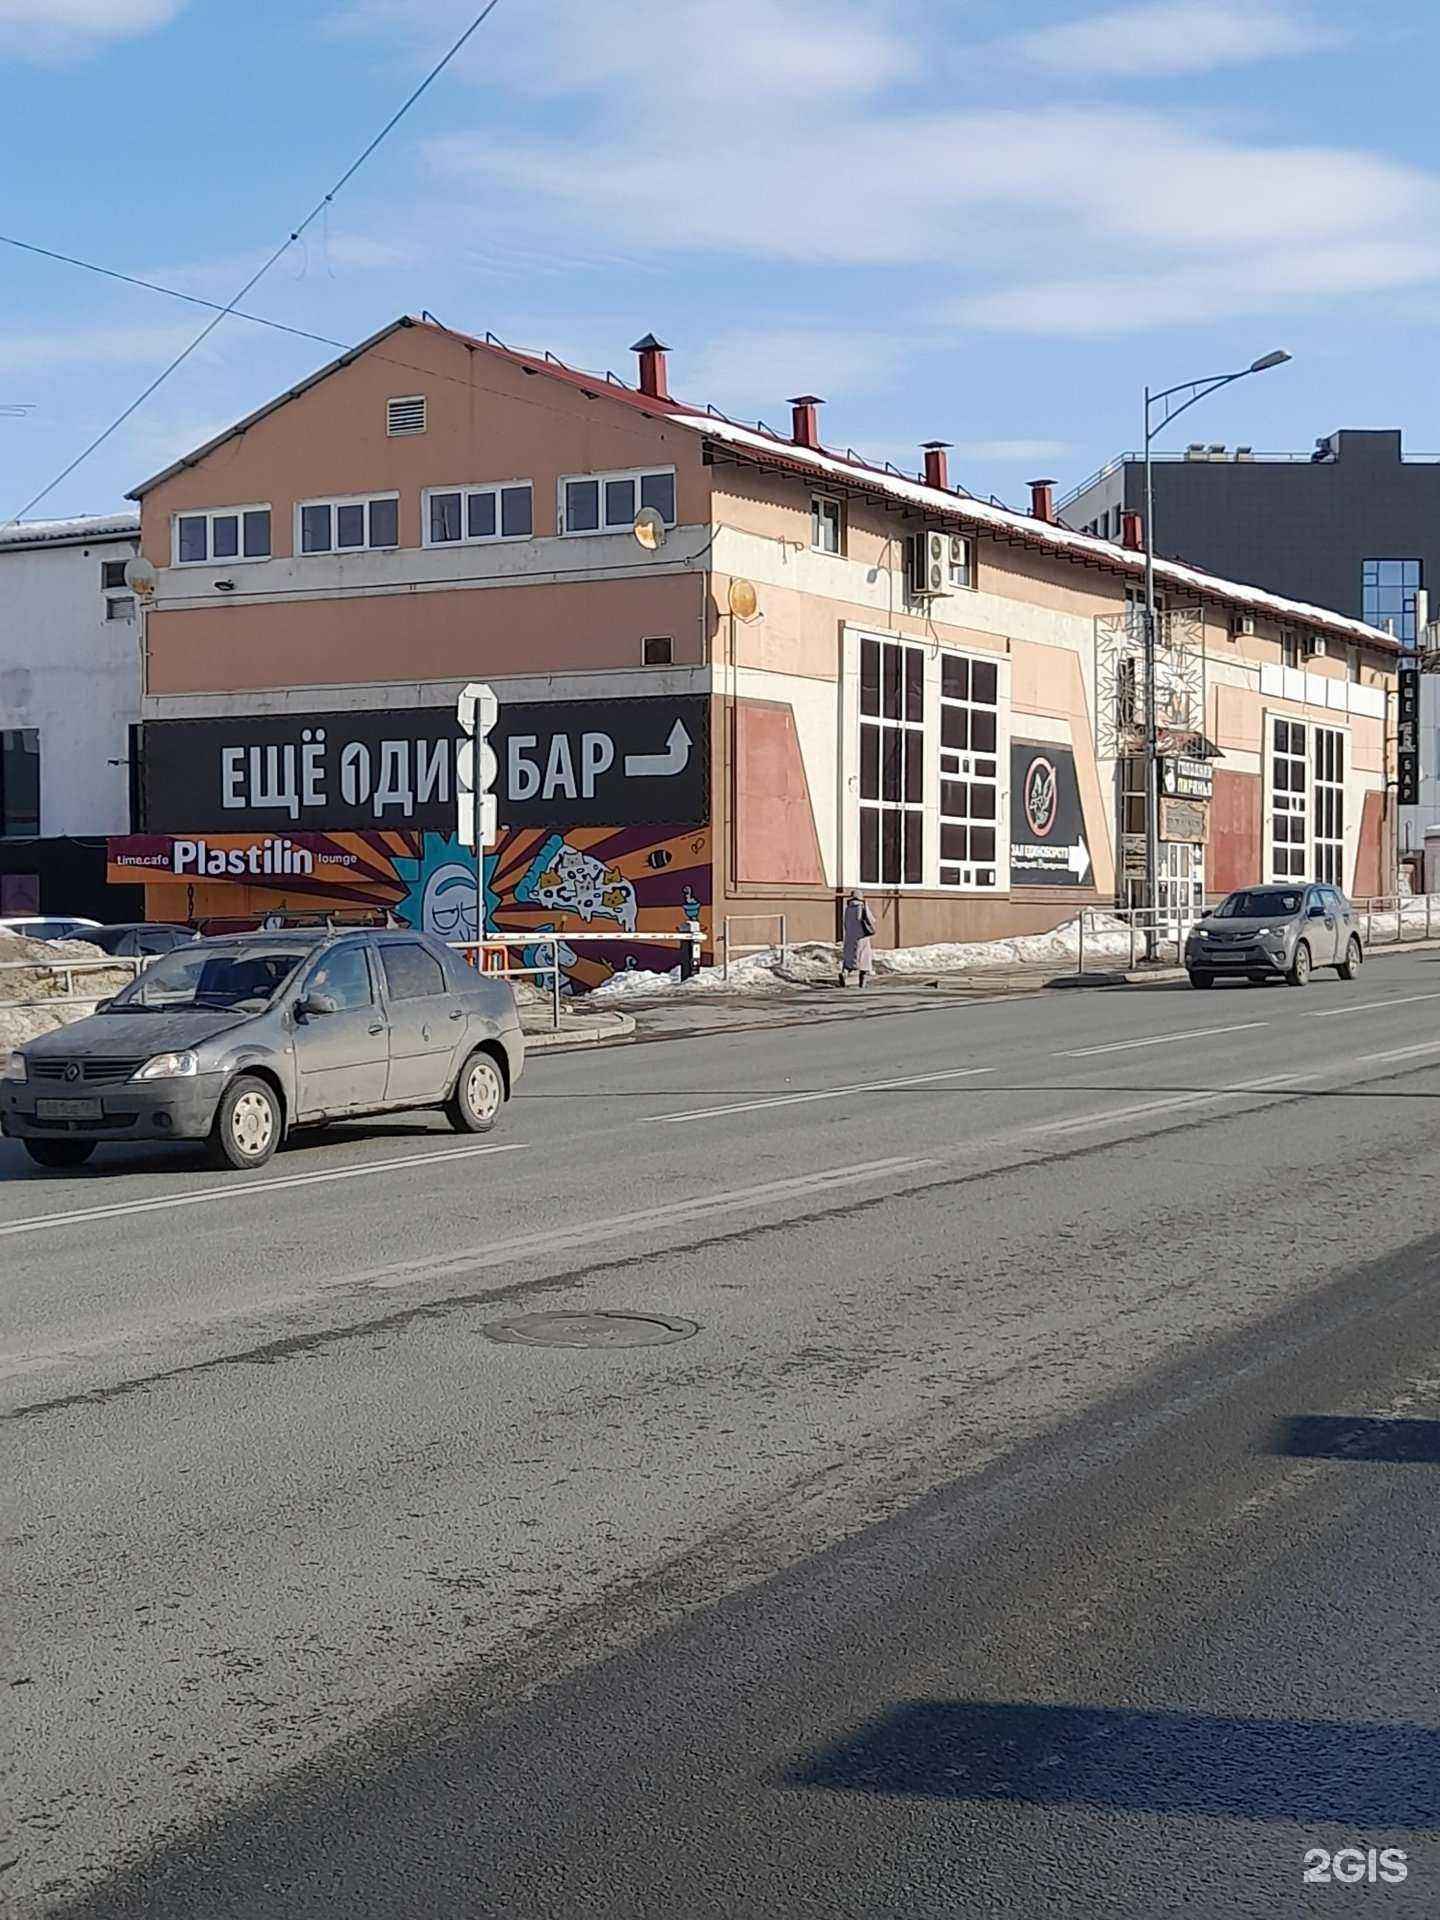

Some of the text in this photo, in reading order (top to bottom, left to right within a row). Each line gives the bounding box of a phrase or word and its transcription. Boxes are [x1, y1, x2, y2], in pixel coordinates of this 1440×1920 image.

[221, 728, 615, 820] ЕЩЁ ОДИ БАР
[173, 839, 313, 875] Plastilin
[318, 853, 357, 866] lounge
